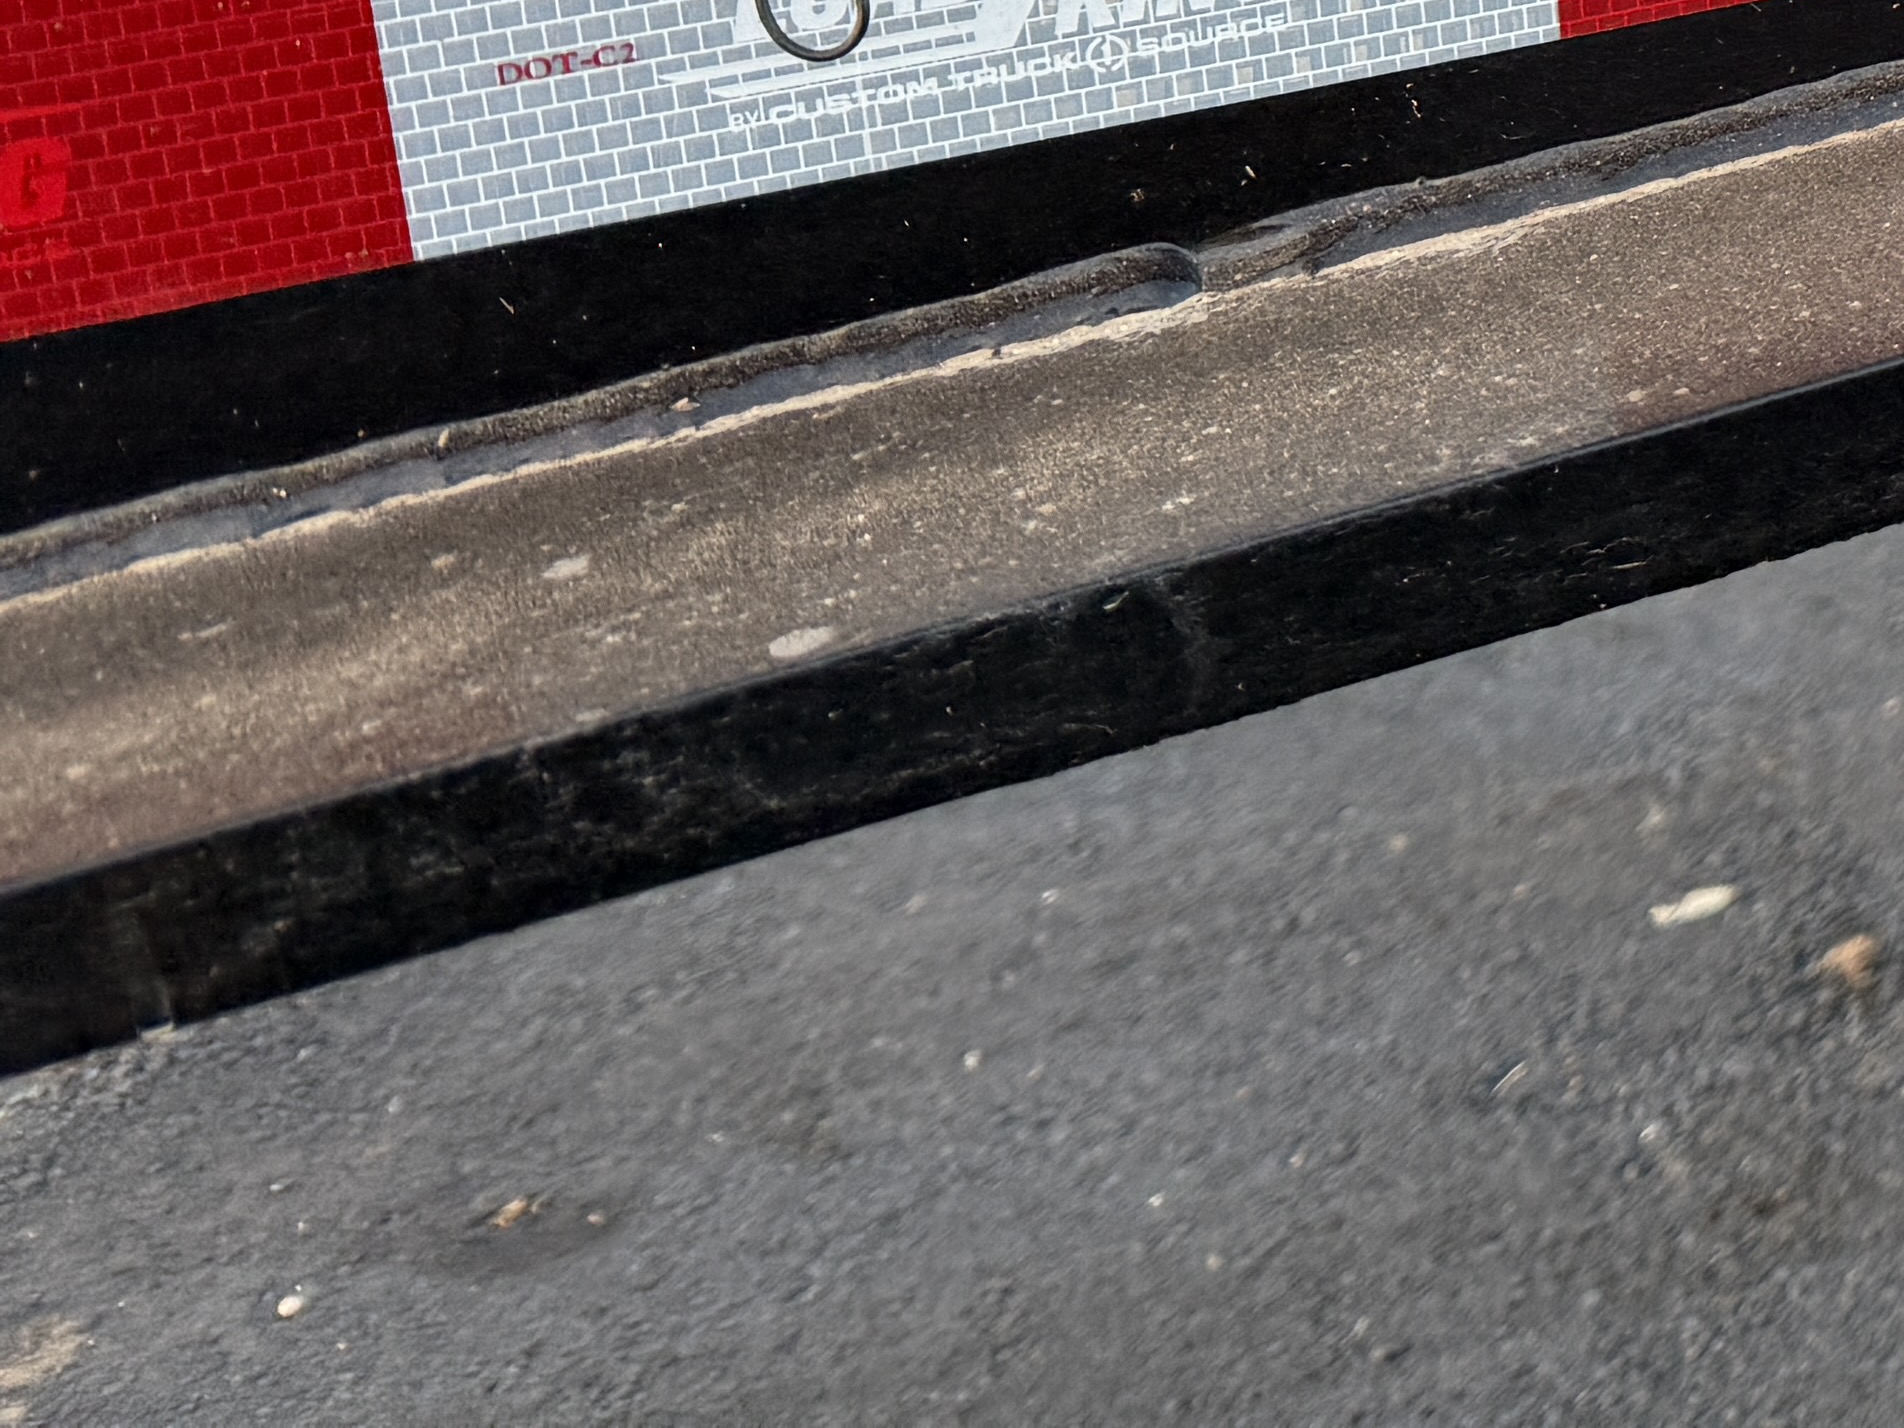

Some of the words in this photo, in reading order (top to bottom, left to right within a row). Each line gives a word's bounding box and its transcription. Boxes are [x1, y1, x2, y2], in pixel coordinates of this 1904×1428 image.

[498, 42, 638, 85] DOT-C2
[729, 110, 759, 132] BY
[769, 78, 940, 124] CUSTOM
[949, 49, 1078, 90] TRUCK
[1136, 12, 1286, 56] SOURCE
